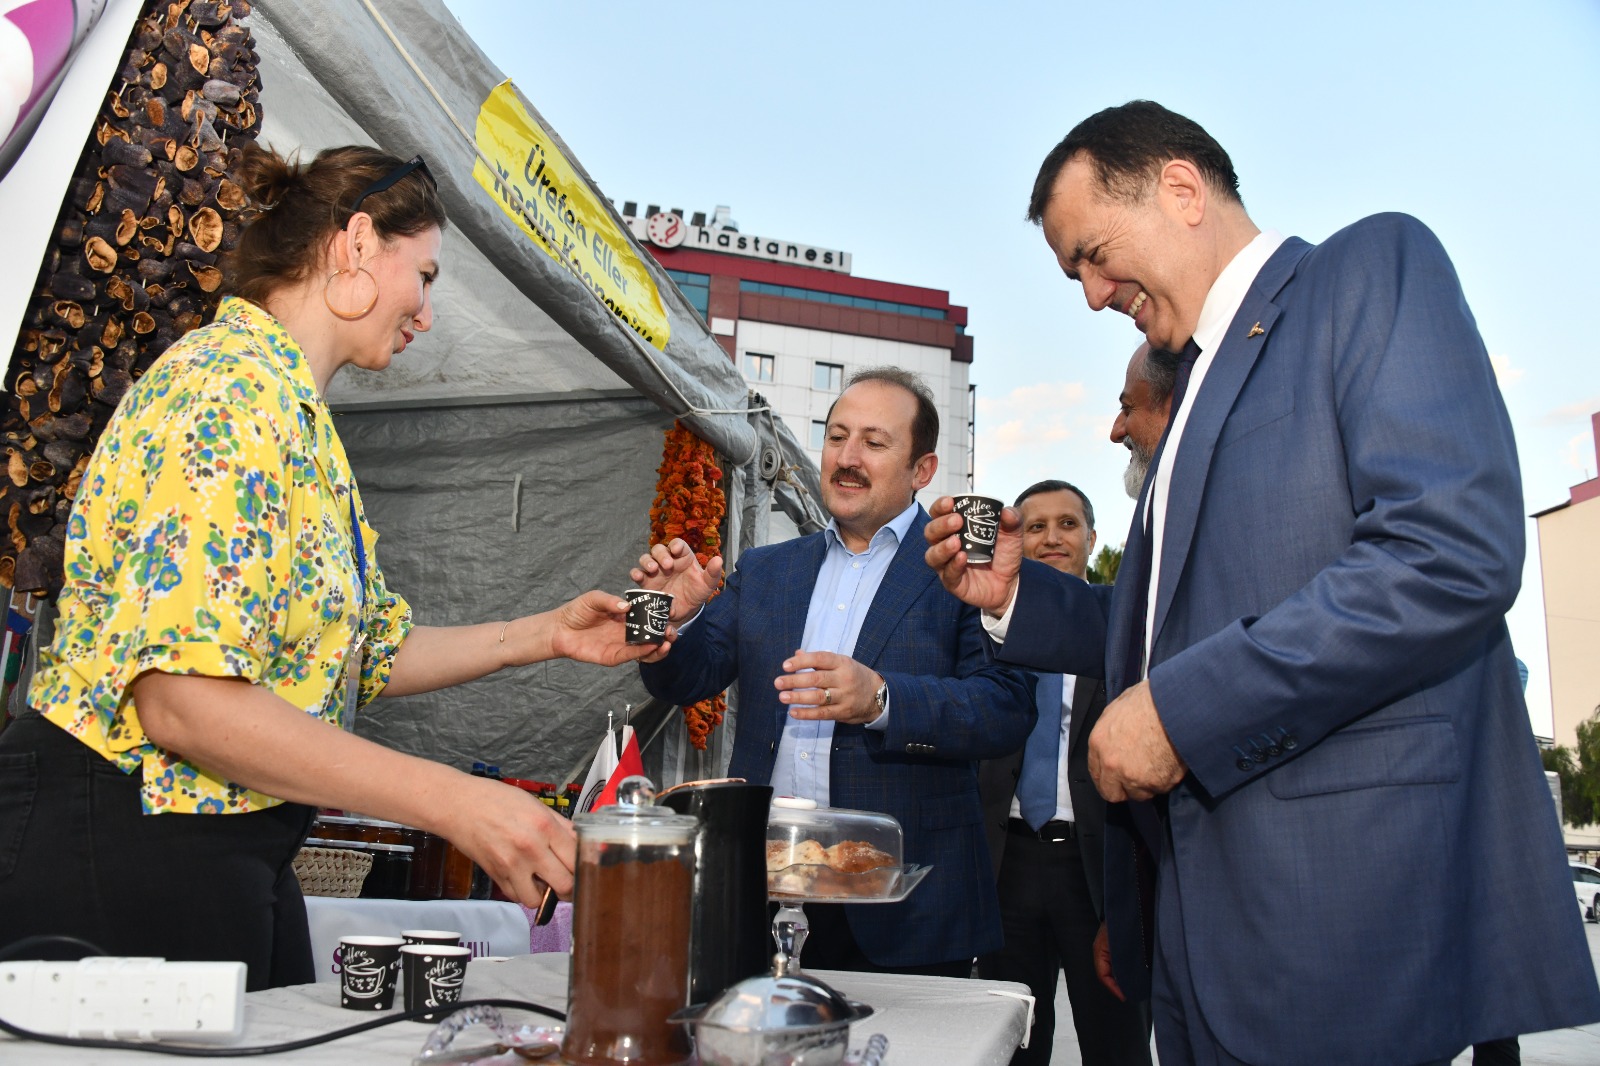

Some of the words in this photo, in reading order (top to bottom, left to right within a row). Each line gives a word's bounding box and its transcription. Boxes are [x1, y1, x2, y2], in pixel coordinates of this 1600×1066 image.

[524, 143, 587, 248] Üreten
[593, 232, 628, 296] Eller
[963, 500, 991, 517] coffee
[644, 596, 668, 611] coffee
[424, 957, 458, 980] coffee
